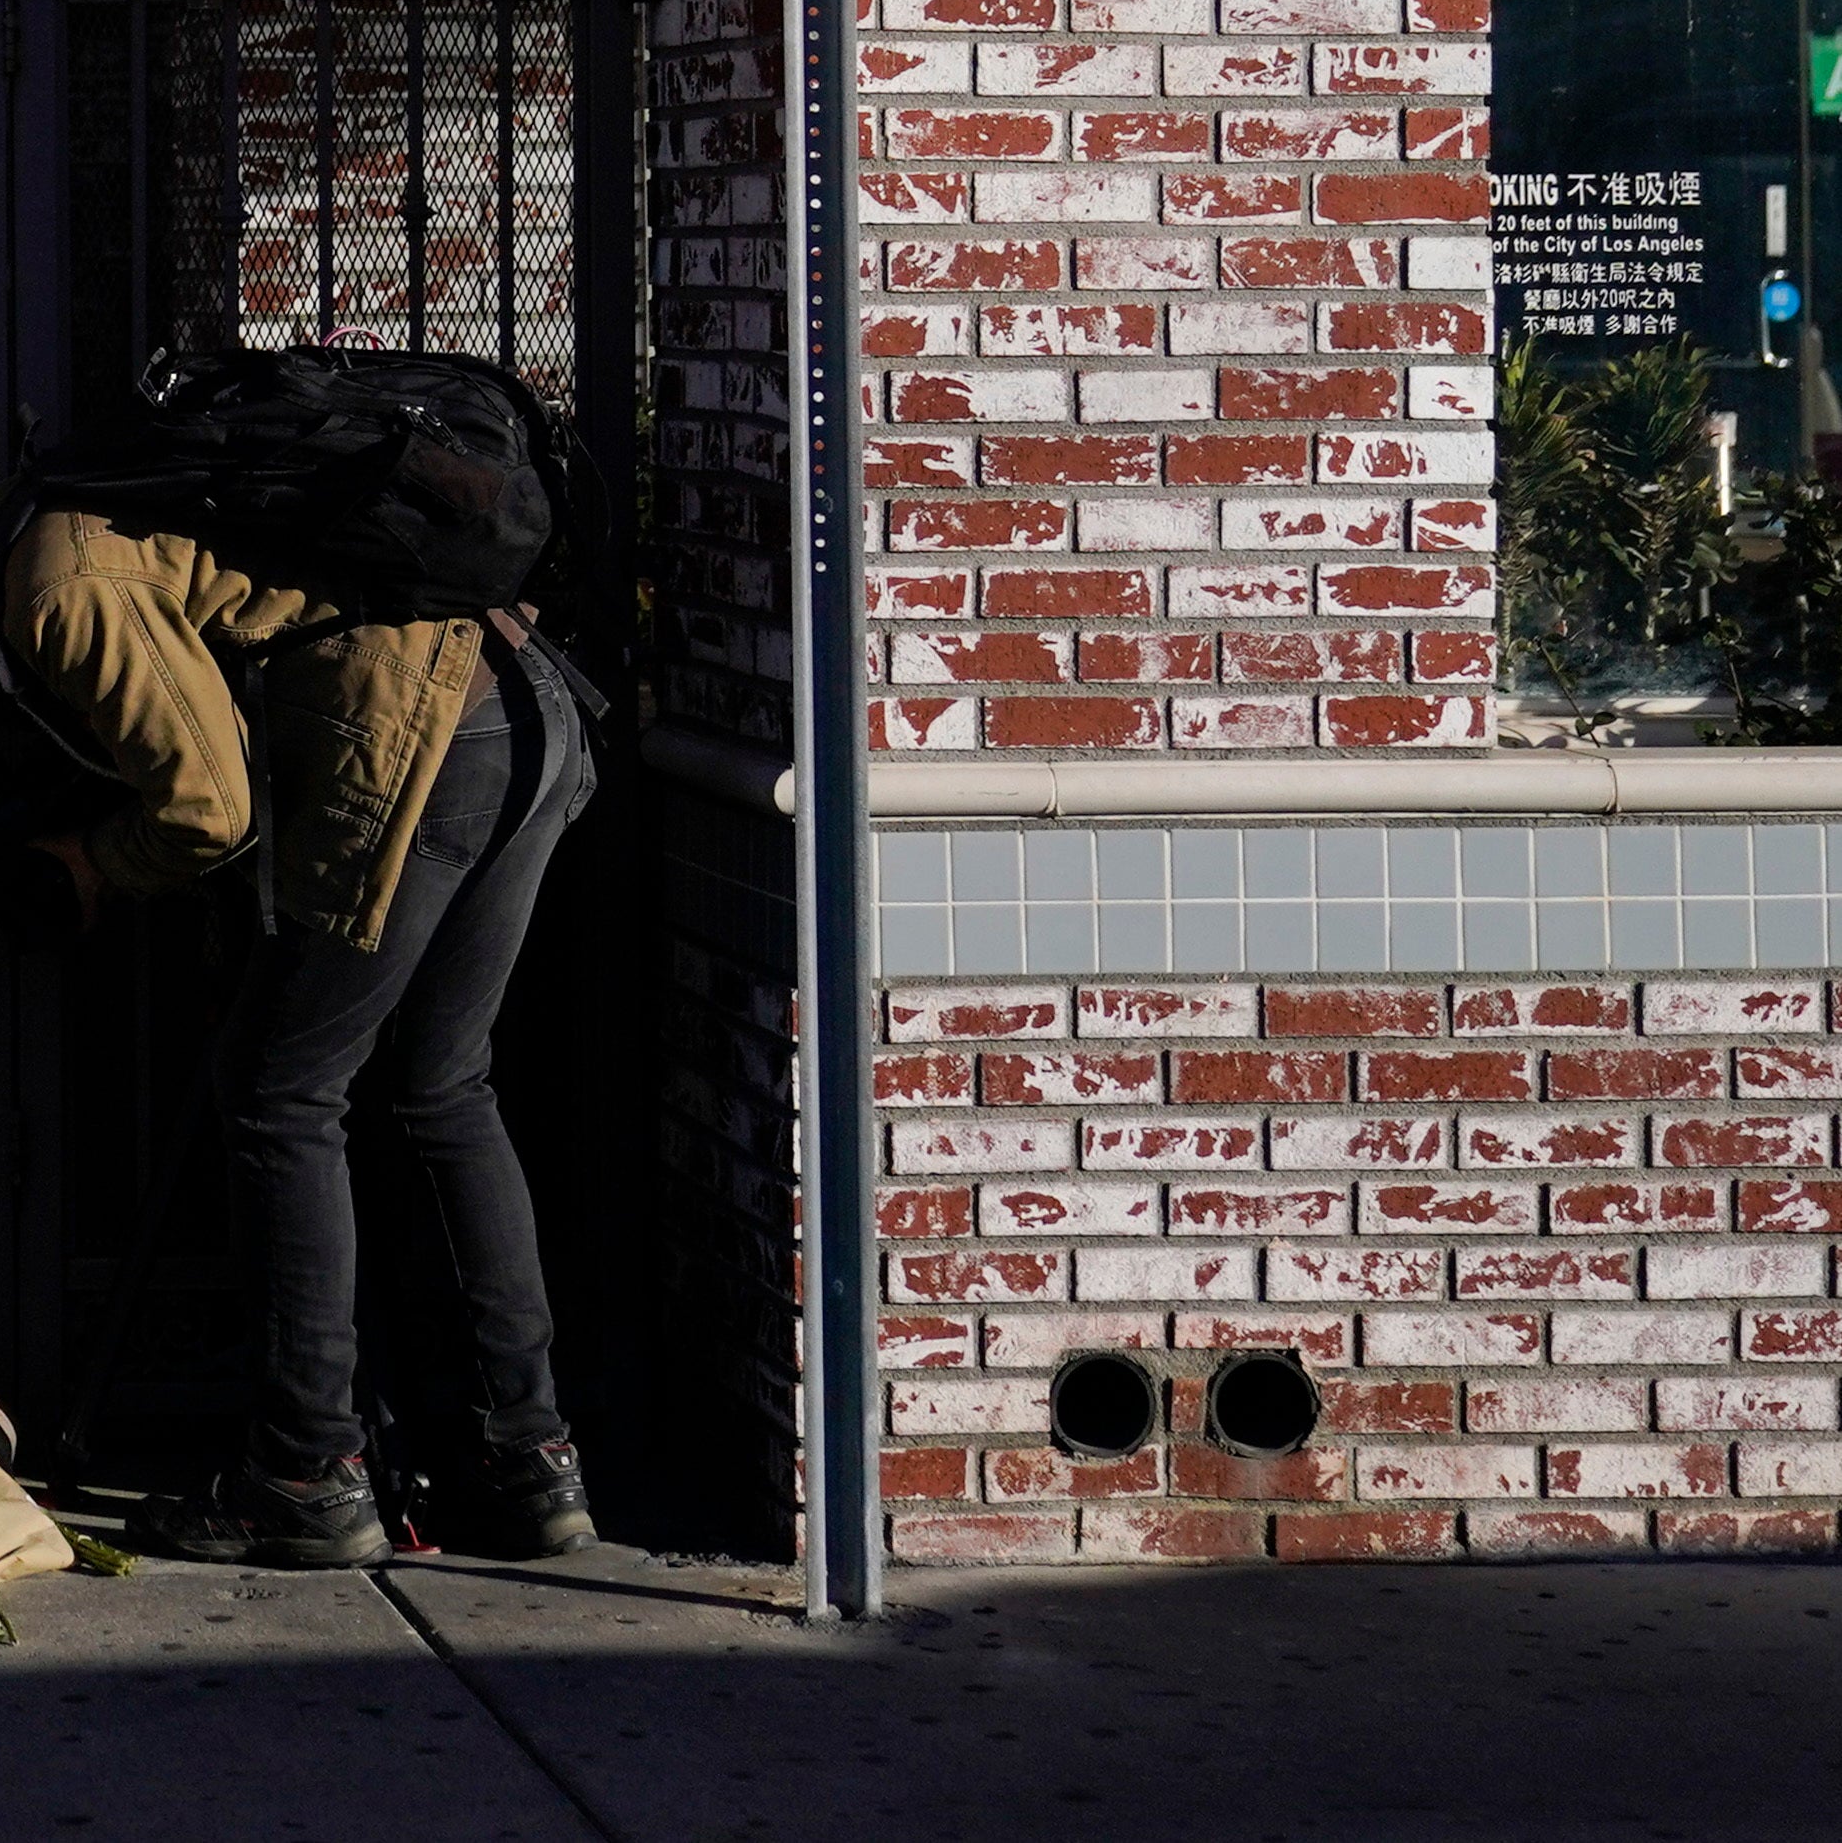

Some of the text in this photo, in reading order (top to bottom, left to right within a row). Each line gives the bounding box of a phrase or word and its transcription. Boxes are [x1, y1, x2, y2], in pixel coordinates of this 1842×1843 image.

[1497, 215, 1516, 232] 20
[1521, 214, 1551, 232] feet
[1555, 214, 1572, 232] of
[1577, 214, 1607, 232] this
[1612, 214, 1679, 234] building
[1493, 235, 1704, 257] of the City of Los Angeles
